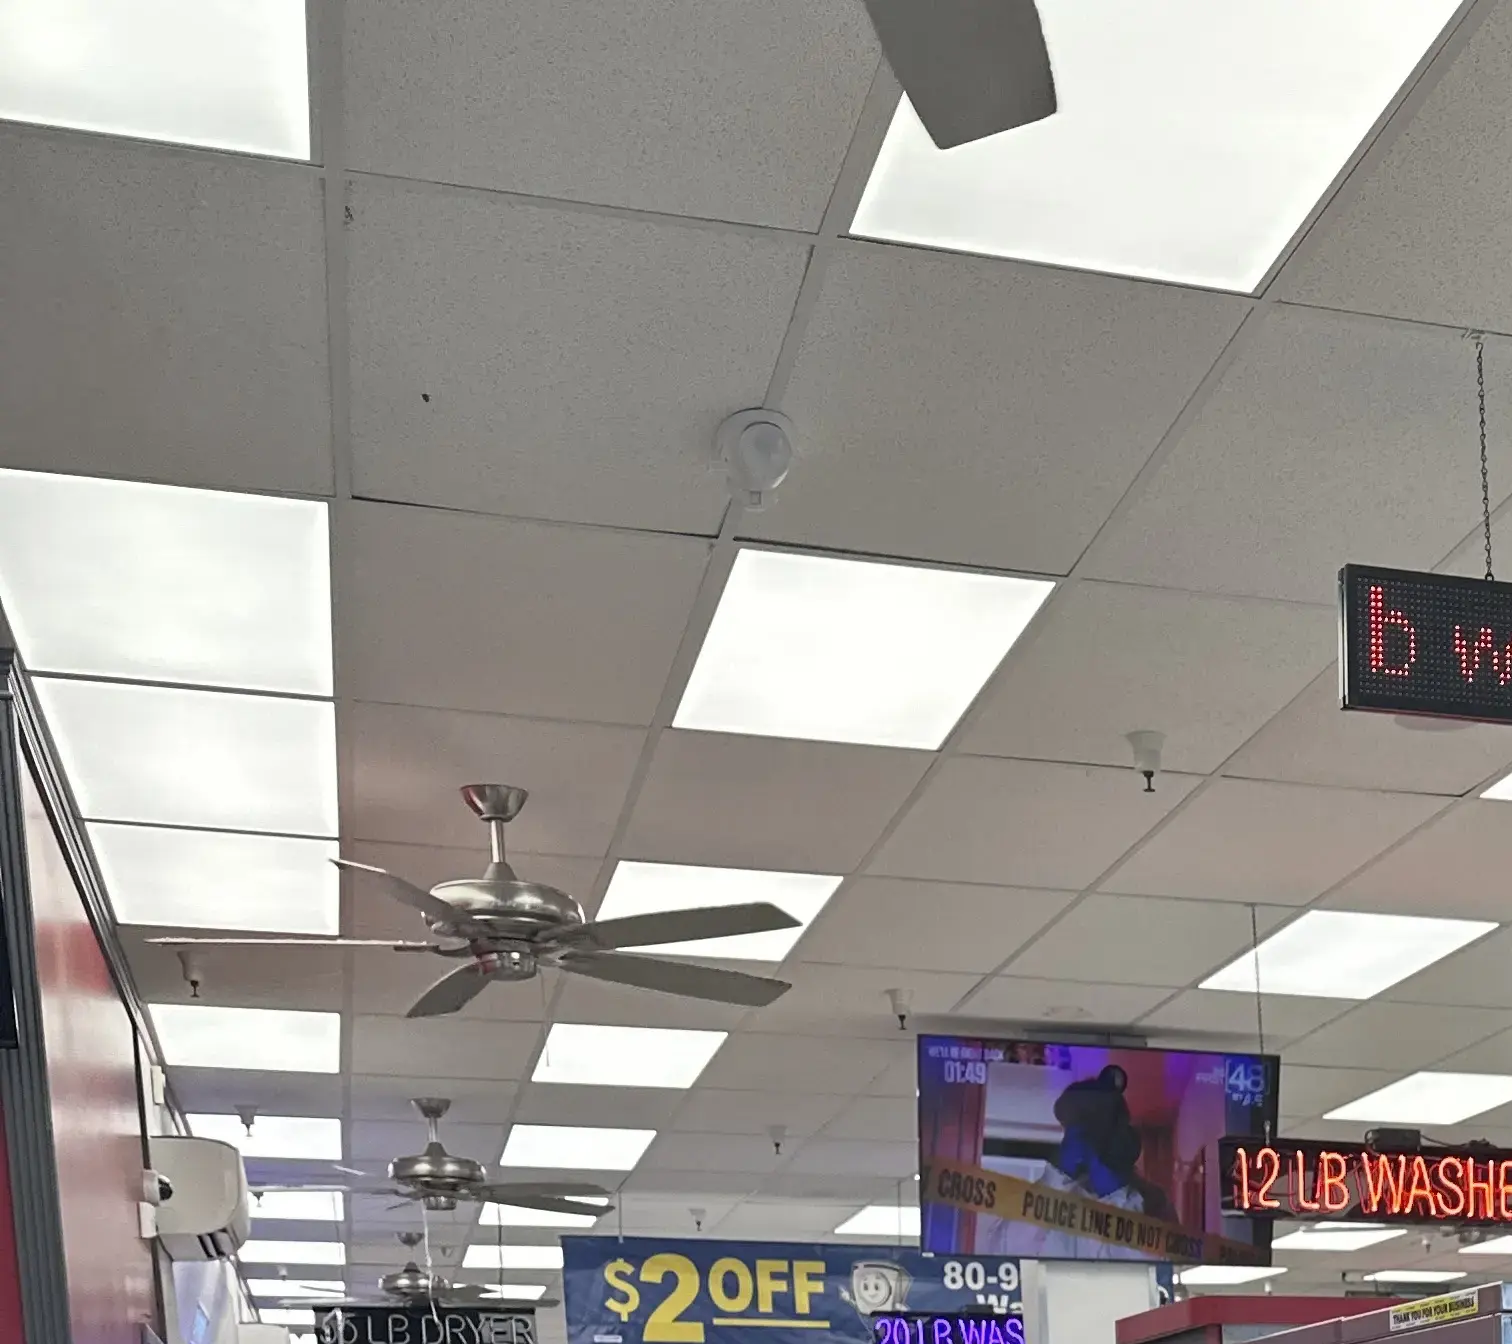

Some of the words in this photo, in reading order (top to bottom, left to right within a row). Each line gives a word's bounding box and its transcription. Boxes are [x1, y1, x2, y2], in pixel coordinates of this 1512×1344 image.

[944, 1060, 986, 1085] 01:49
[1236, 1147, 1280, 1210] 12
[1296, 1150, 1350, 1212] LB
[937, 1169, 997, 1208] CROSS
[1022, 1191, 1076, 1229] POLICE
[1080, 1205, 1111, 1236] LINE
[1115, 1216, 1133, 1242] DO
[1137, 1221, 1163, 1250] NOT
[708, 1257, 827, 1315] OFF
[943, 1261, 1020, 1292] 80-9
